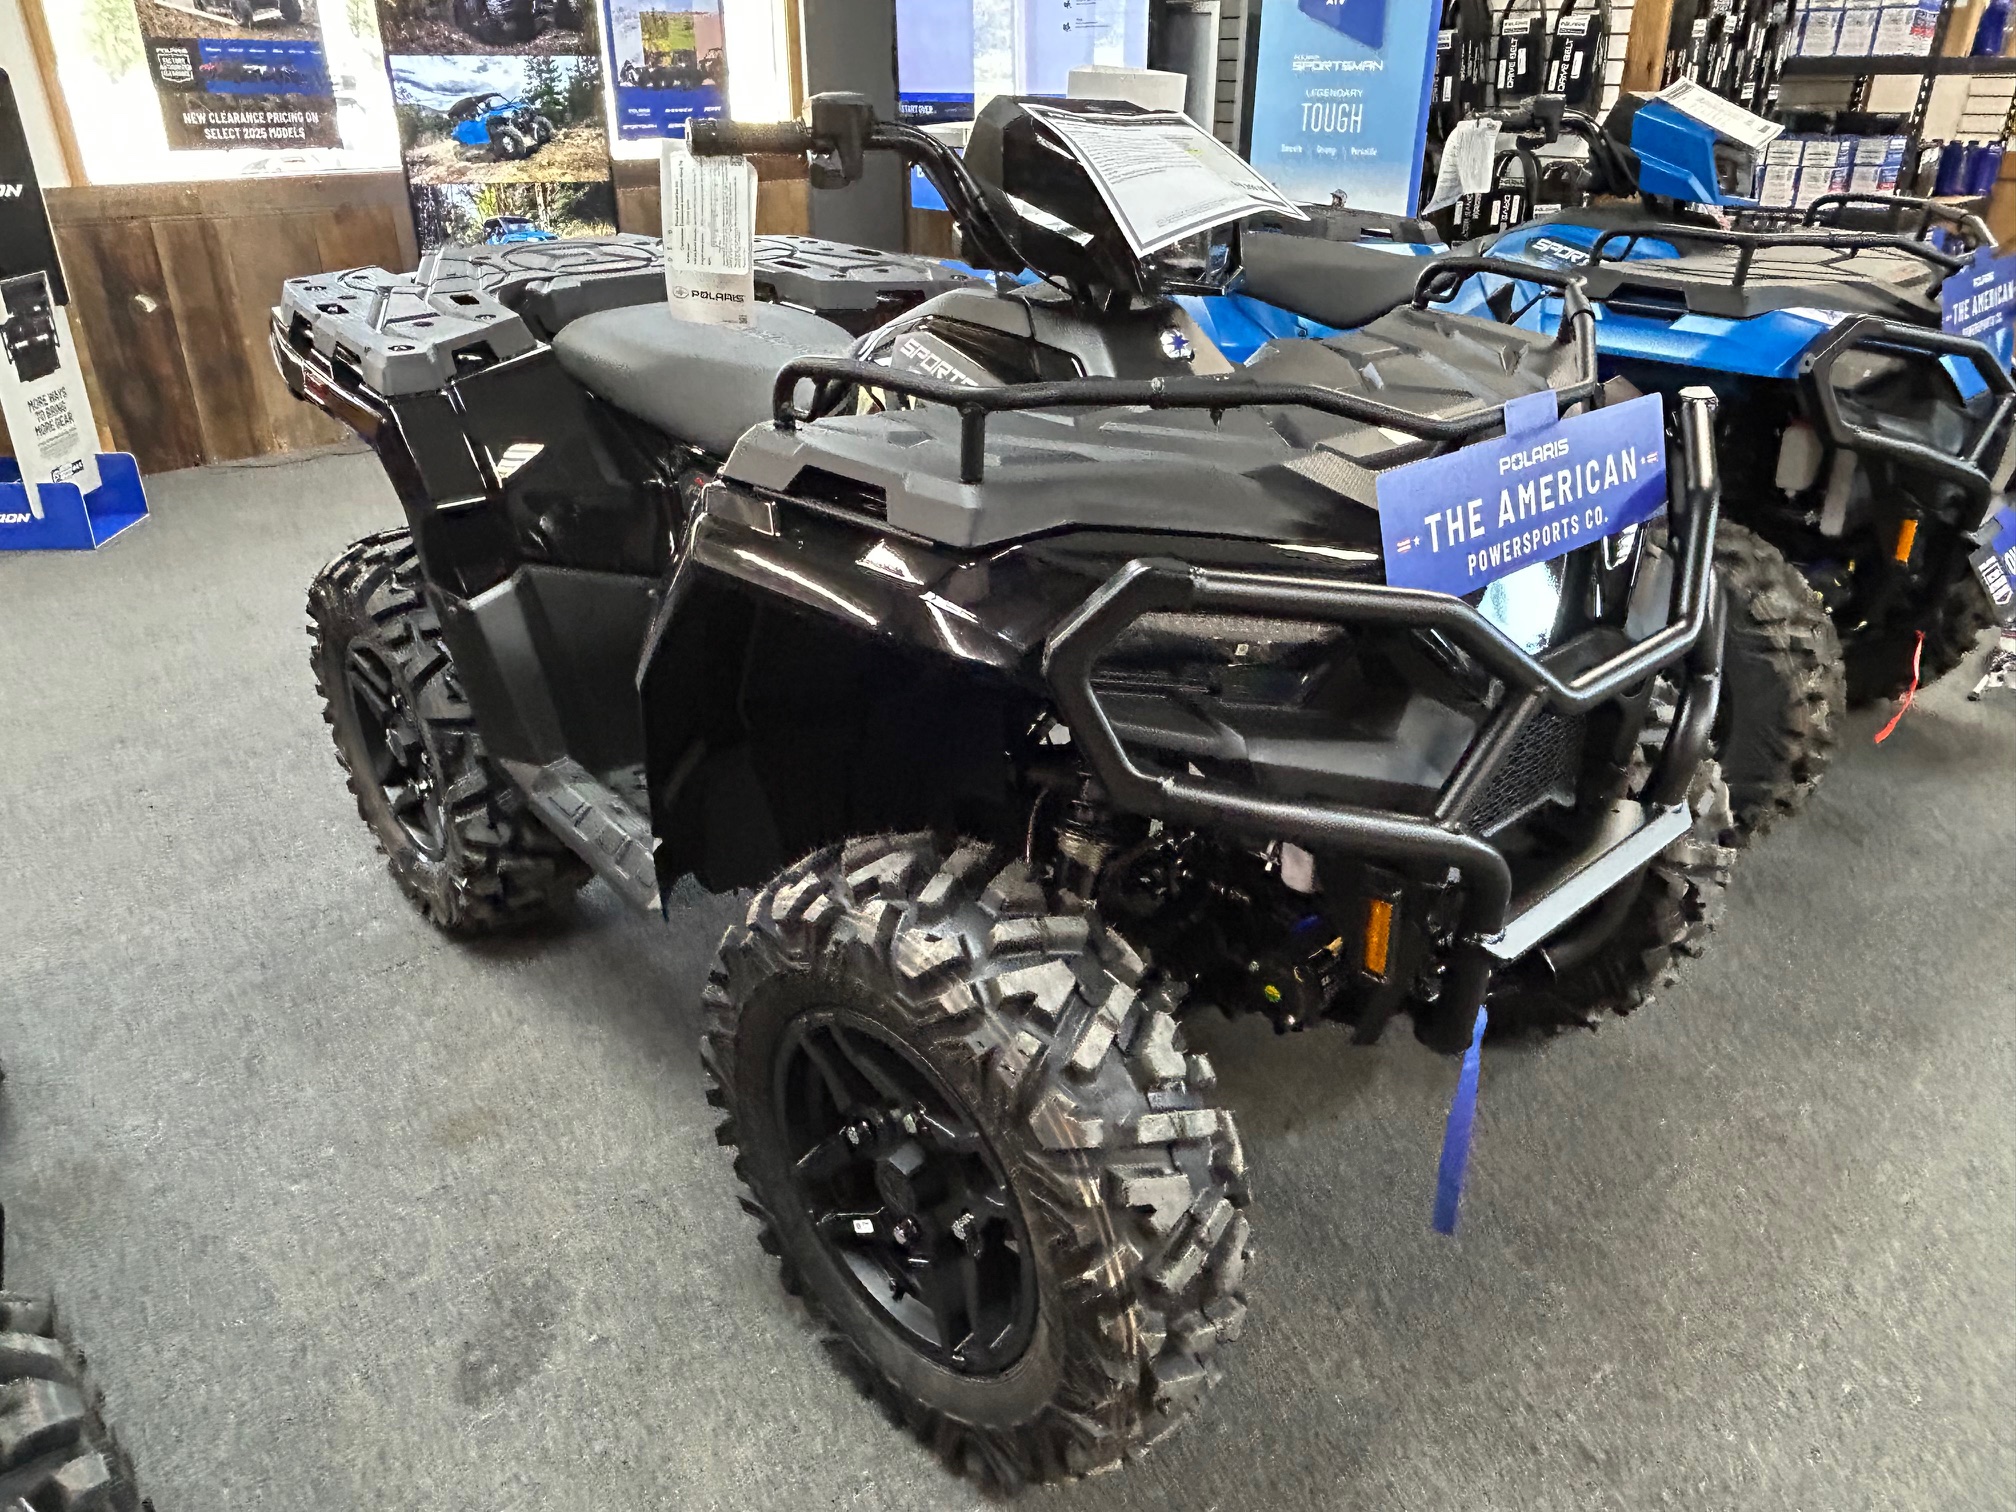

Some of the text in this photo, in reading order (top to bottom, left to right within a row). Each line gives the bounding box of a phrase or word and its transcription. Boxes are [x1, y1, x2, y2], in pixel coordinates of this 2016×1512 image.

[1506, 37, 1518, 89] DRIVE BELT
[1562, 38, 1573, 61] BELT
[1291, 59, 1384, 72] SPORTSMAN
[1557, 63, 1569, 91] DRIVE
[1305, 88, 1364, 98] LEGENDARY
[182, 111, 319, 125] NEW CLEARANCE PRICING ON
[1300, 102, 1363, 133] TOUGH
[204, 127, 306, 140] SELECT 2025 MODELS
[691, 290, 745, 303] POLARIS
[1952, 279, 2014, 325] THE AMERICAN
[34, 411, 75, 437] MORE GEAR
[1499, 437, 1570, 476] POLARIS
[1424, 446, 1637, 553] THE AMERICAN
[1467, 505, 1609, 577] POWERSPORTS CO.
